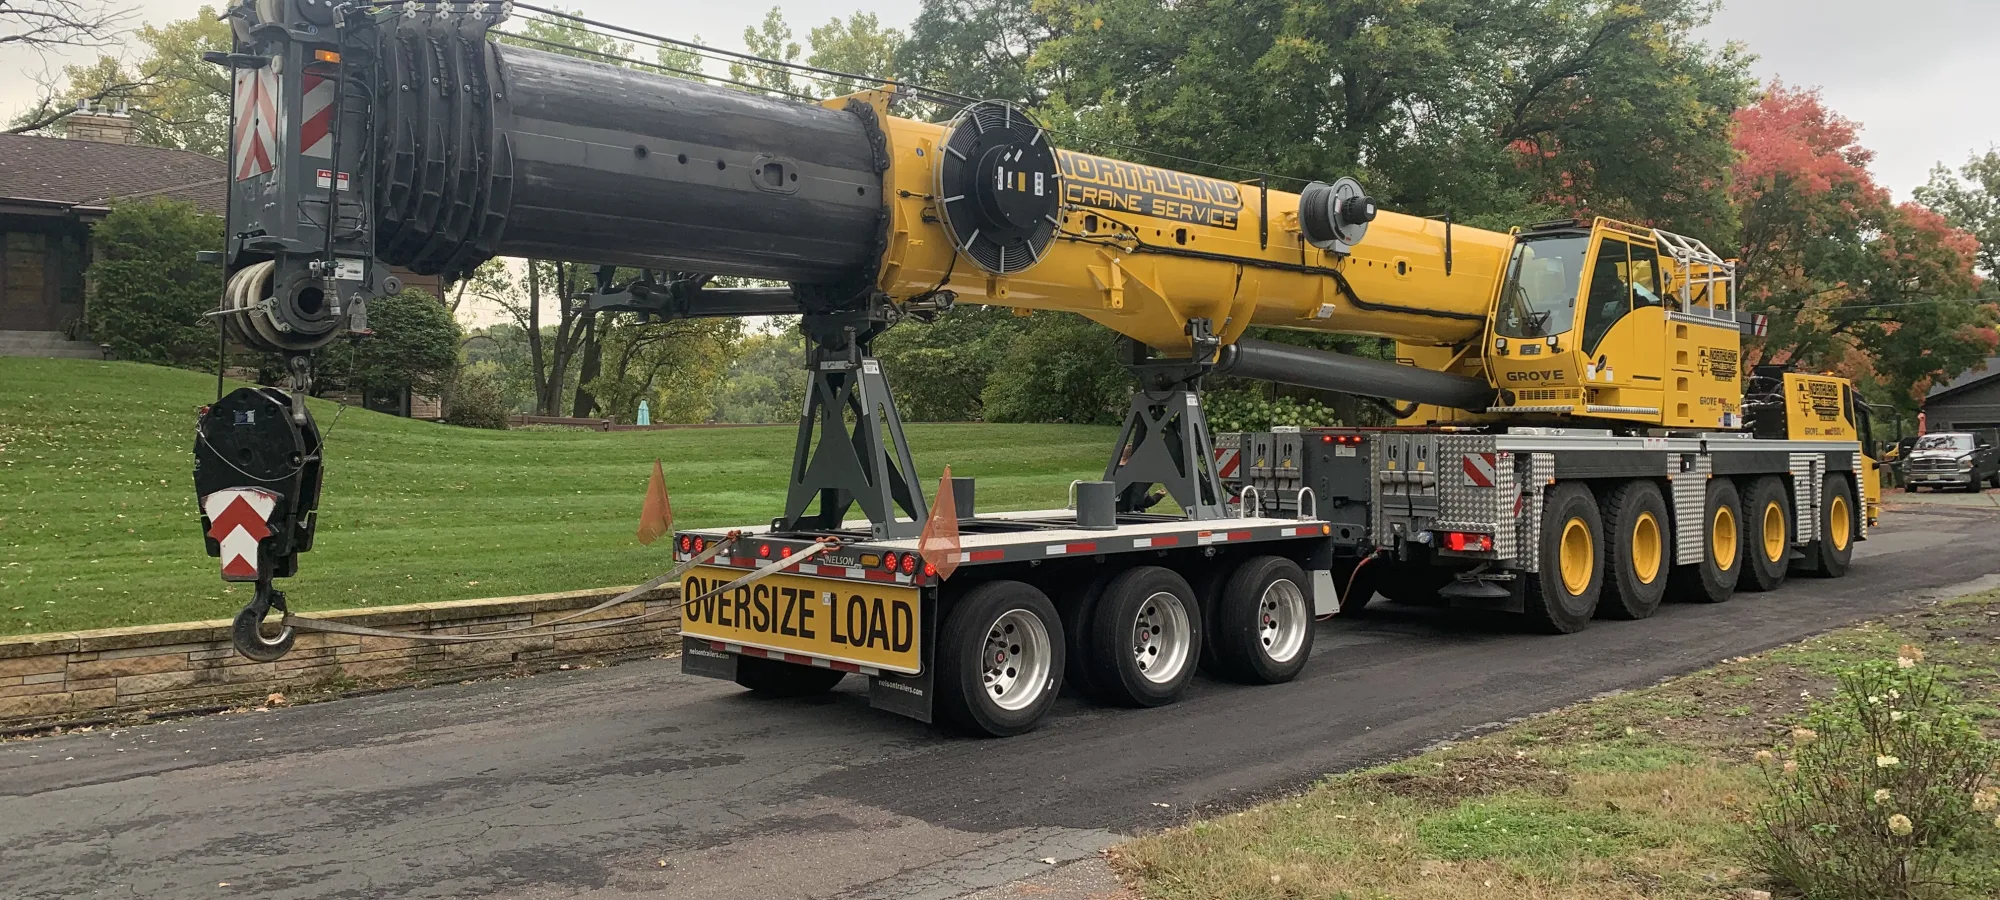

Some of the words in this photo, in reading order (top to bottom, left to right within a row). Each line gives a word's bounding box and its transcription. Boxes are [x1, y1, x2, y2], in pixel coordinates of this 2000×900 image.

[1058, 150, 1243, 210] NORTHLAND
[1066, 184, 1143, 212] CRANE
[1152, 199, 1237, 228] SERVICE
[1709, 348, 1738, 363] NORTHLAND
[1506, 370, 1564, 381] GROVE
[1808, 381, 1838, 398] NORTHLAND
[1700, 396, 1717, 406] GROVE
[1804, 427, 1818, 436] GROVE
[825, 555, 854, 566] NELSON
[685, 576, 815, 639] OVERSIZE
[830, 592, 913, 653] LOAD
[689, 648, 729, 660] nelsontrailers.com
[879, 680, 923, 696] nelsontrailers.com
